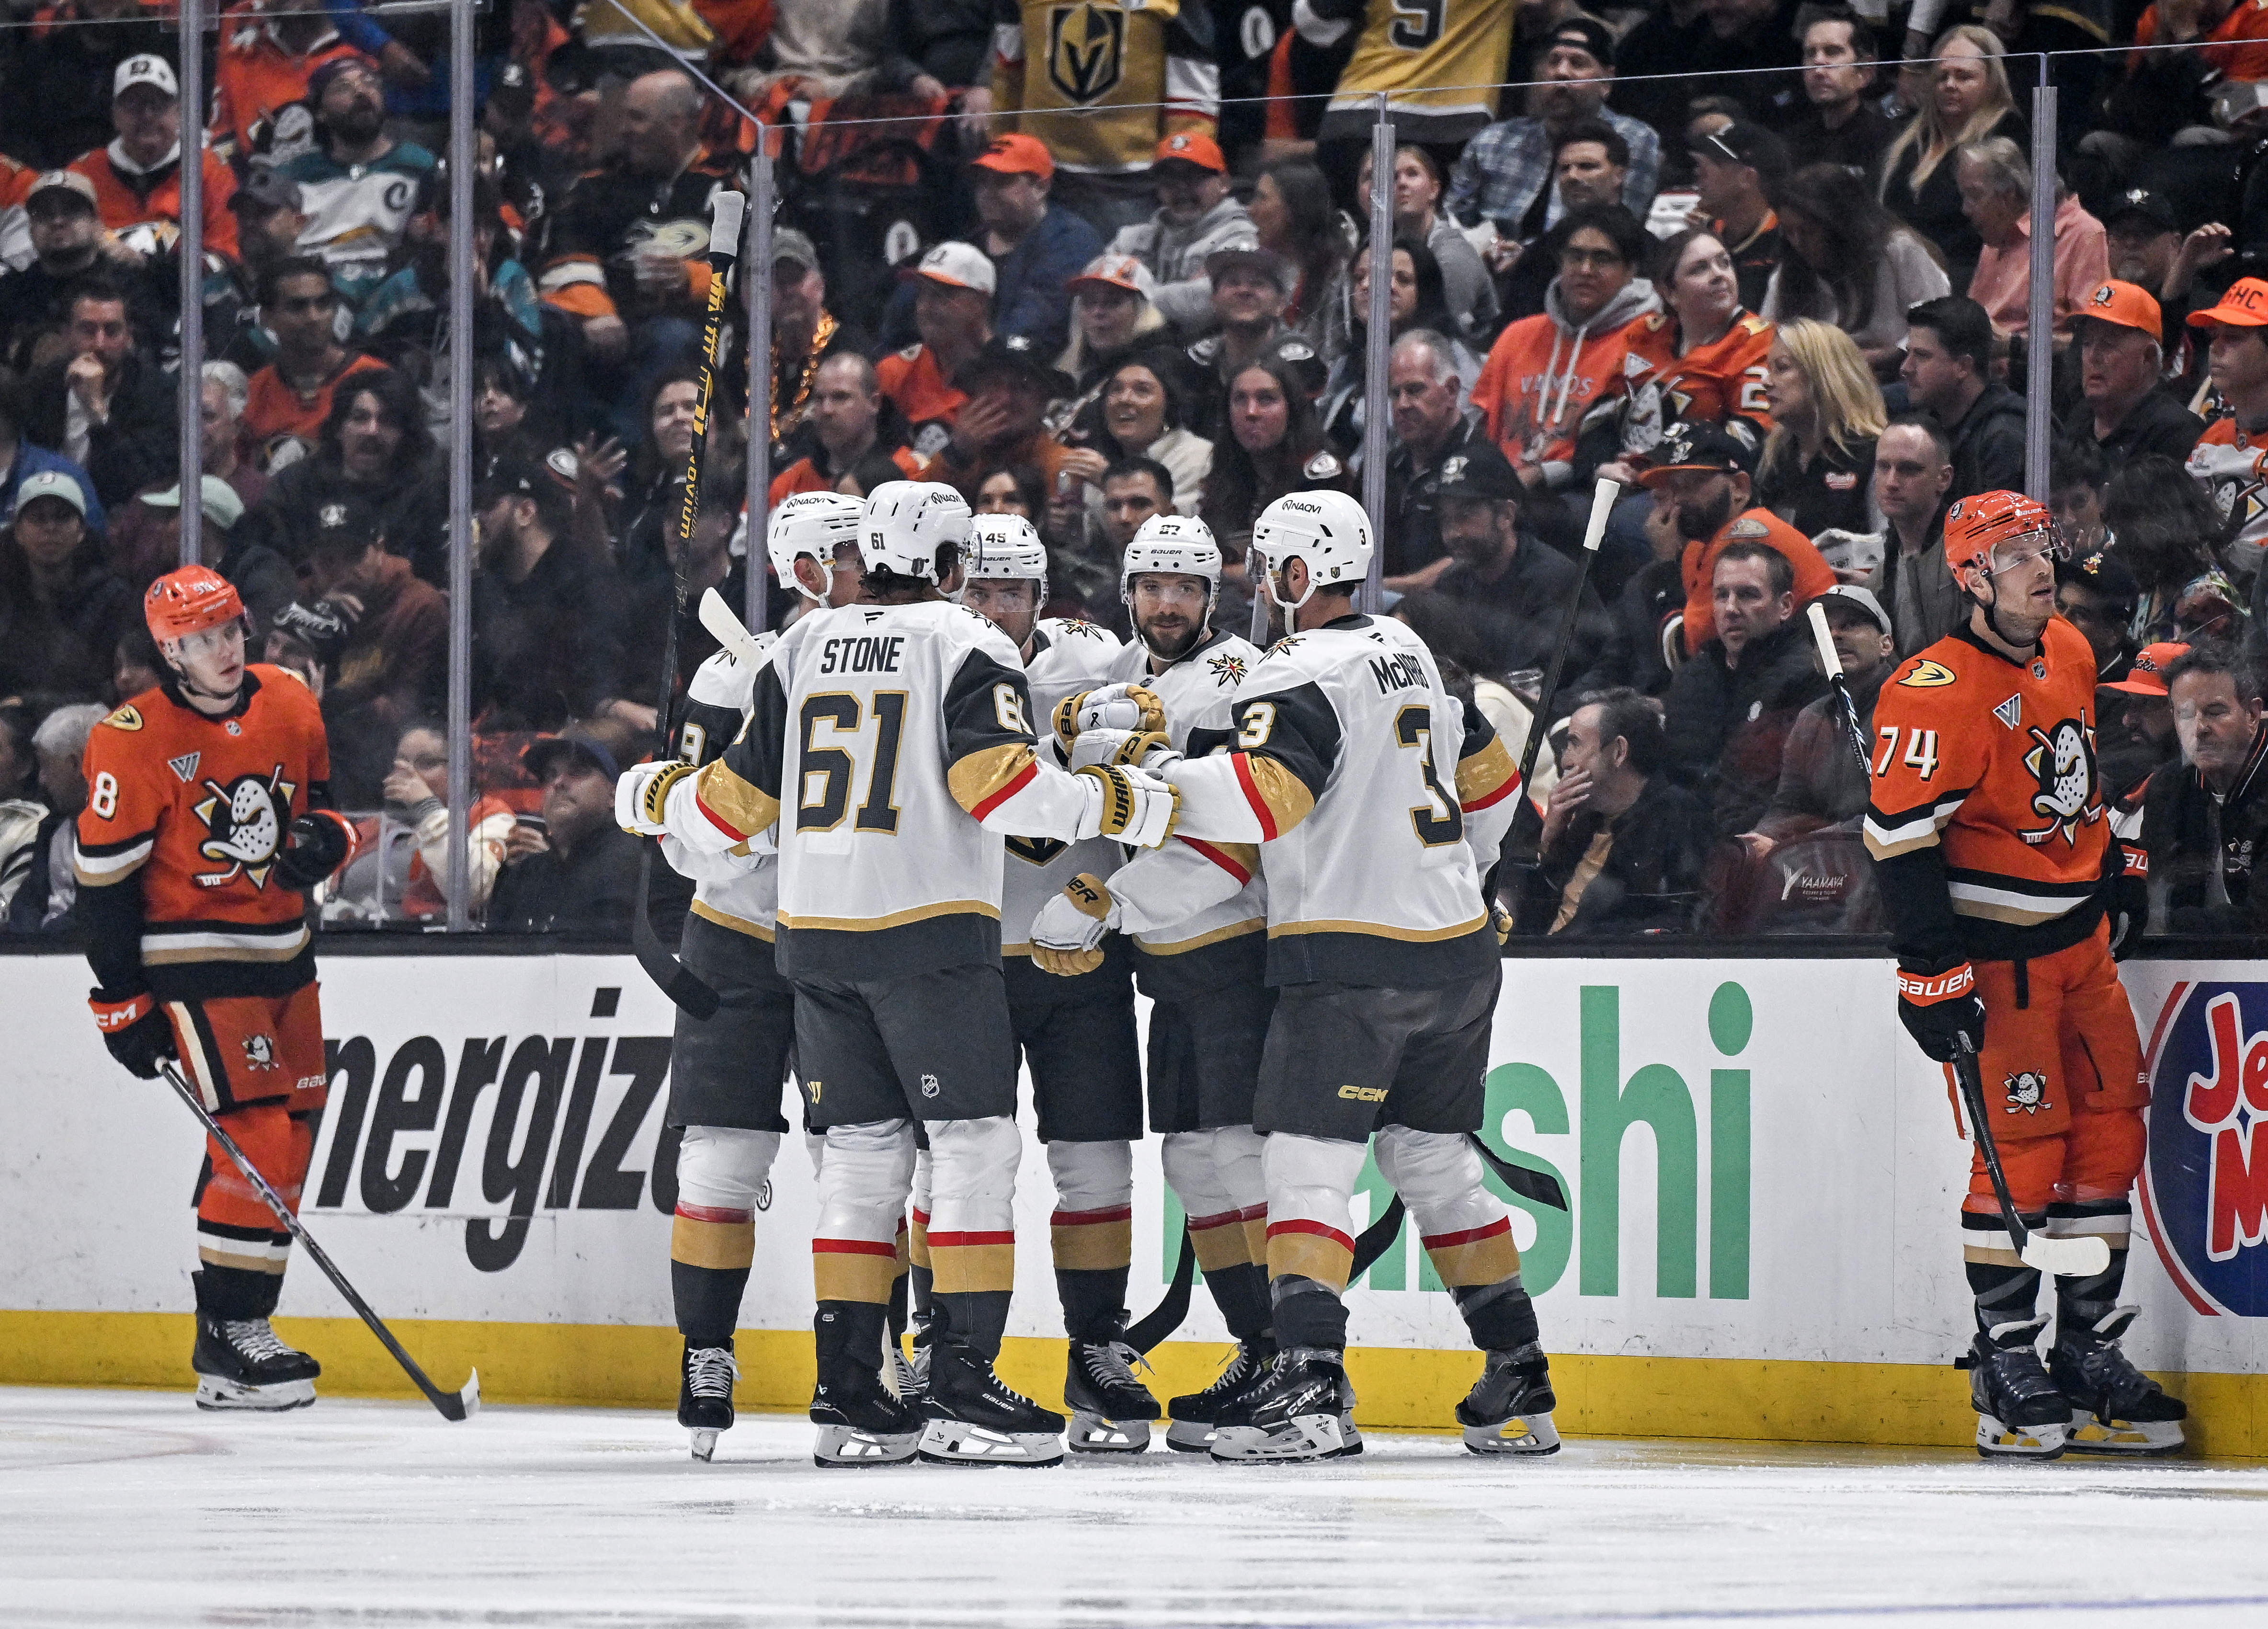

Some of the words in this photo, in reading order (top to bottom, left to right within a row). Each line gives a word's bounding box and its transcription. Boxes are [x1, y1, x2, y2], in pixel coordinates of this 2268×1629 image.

[1741, 366, 1770, 409] 2
[796, 498, 826, 506] NAQVI
[939, 494, 961, 504] NAQVI
[1292, 502, 1322, 514] NAQVI
[871, 532, 886, 550] 61
[985, 533, 1006, 543] 45
[1359, 528, 1366, 545] 3
[820, 637, 905, 674] STONE
[993, 683, 1036, 737] 61
[1238, 702, 1276, 749] 3
[797, 689, 910, 837] 61
[1877, 726, 1938, 780] 74
[1393, 703, 1465, 848] 3
[1898, 966, 1974, 997] BAUER
[94, 1003, 137, 1027] CM
[1337, 1085, 1389, 1103] CCM
[192, 987, 789, 1273] nergiz
[873, 1399, 895, 1417] BAUER
[982, 1392, 1015, 1412] BAUER
[1287, 1384, 1322, 1416] CCM
[1509, 1390, 1523, 1408] TACKS
